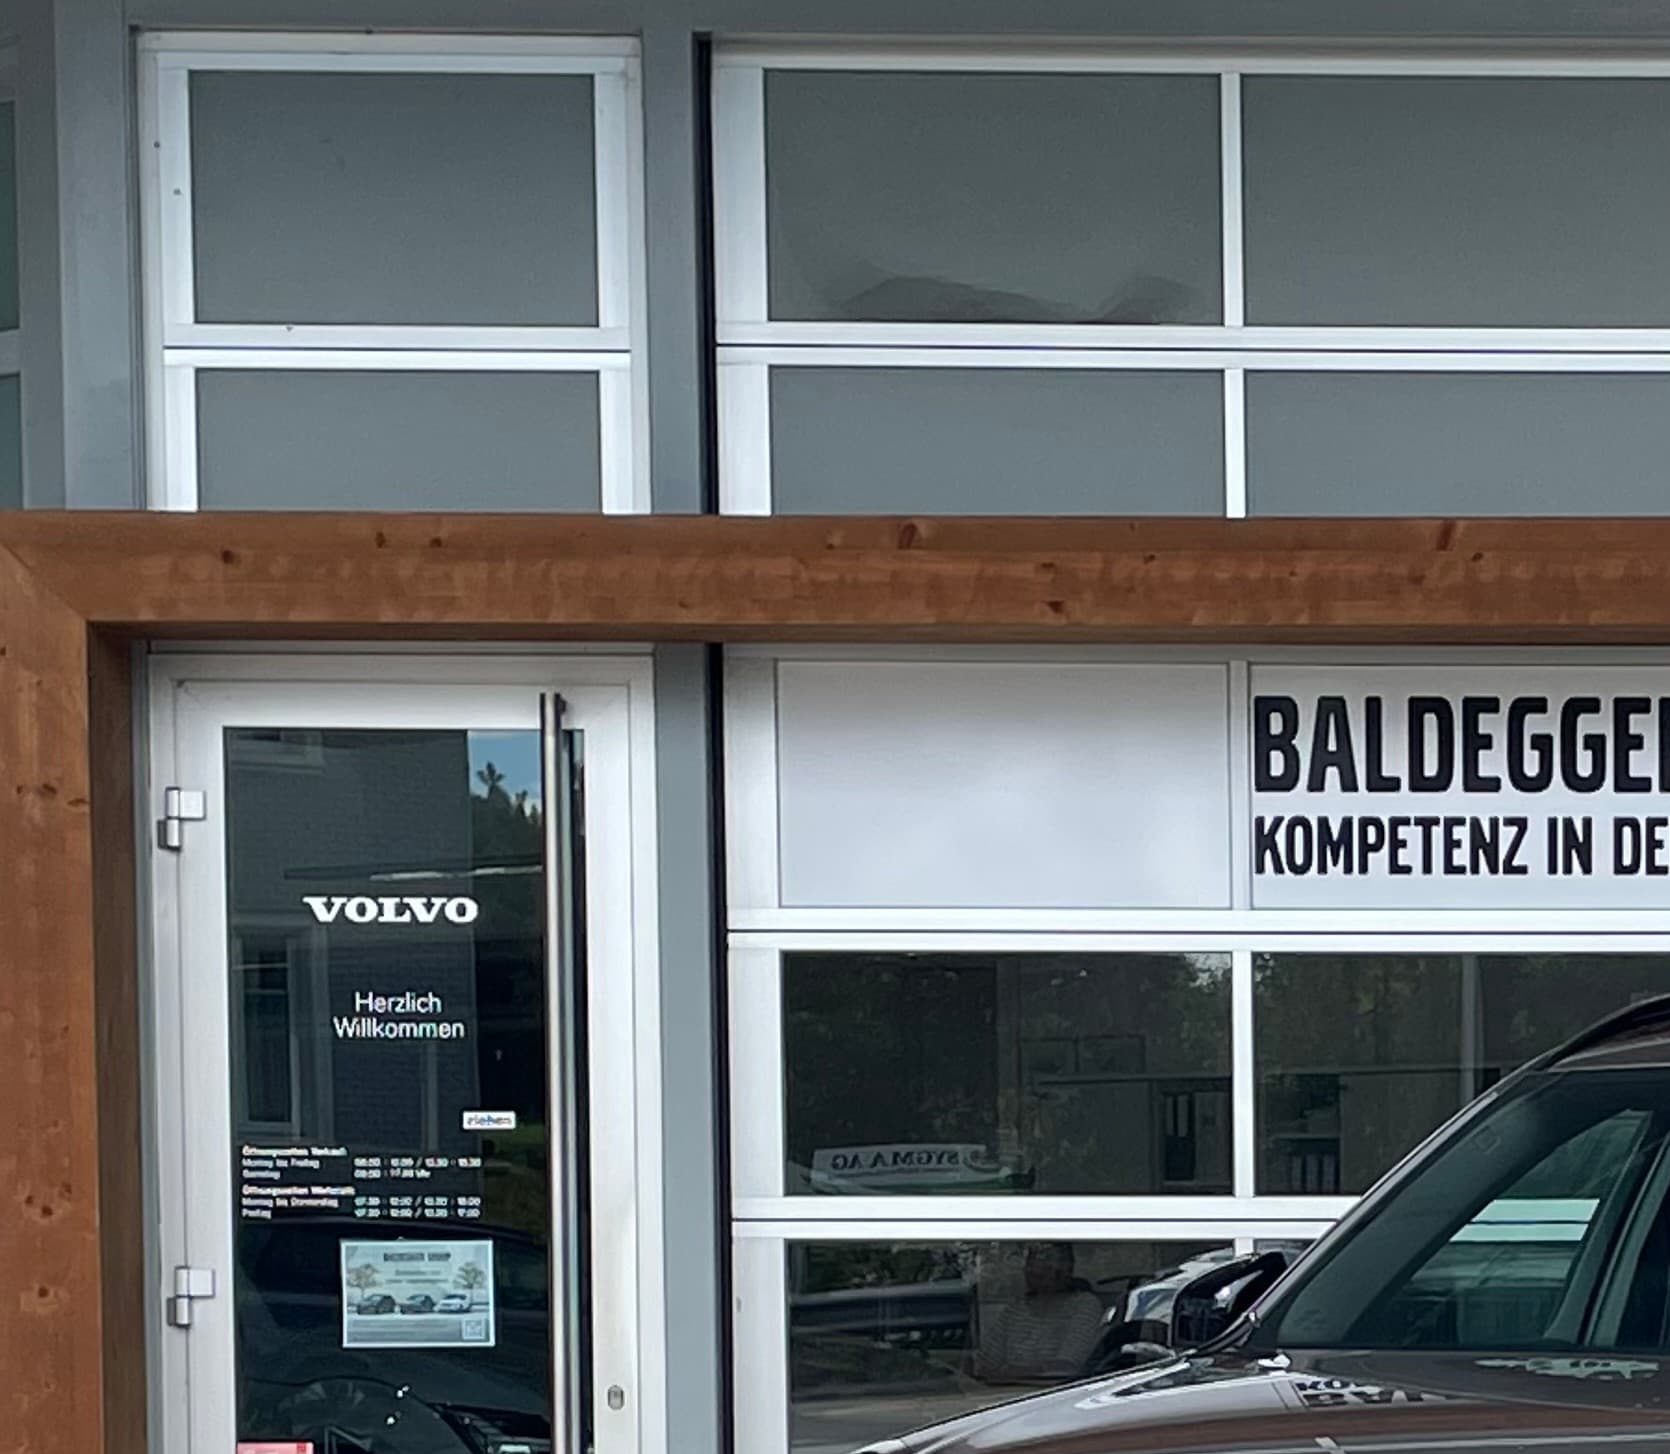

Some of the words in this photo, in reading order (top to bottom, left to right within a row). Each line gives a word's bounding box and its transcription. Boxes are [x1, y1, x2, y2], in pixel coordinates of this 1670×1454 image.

[1253, 816, 1529, 876] KOMPETENZ
[1546, 816, 1593, 876] IN
[303, 896, 479, 923] VOLVO
[354, 991, 442, 1014] Herzlich
[333, 1016, 465, 1038] Willkommen
